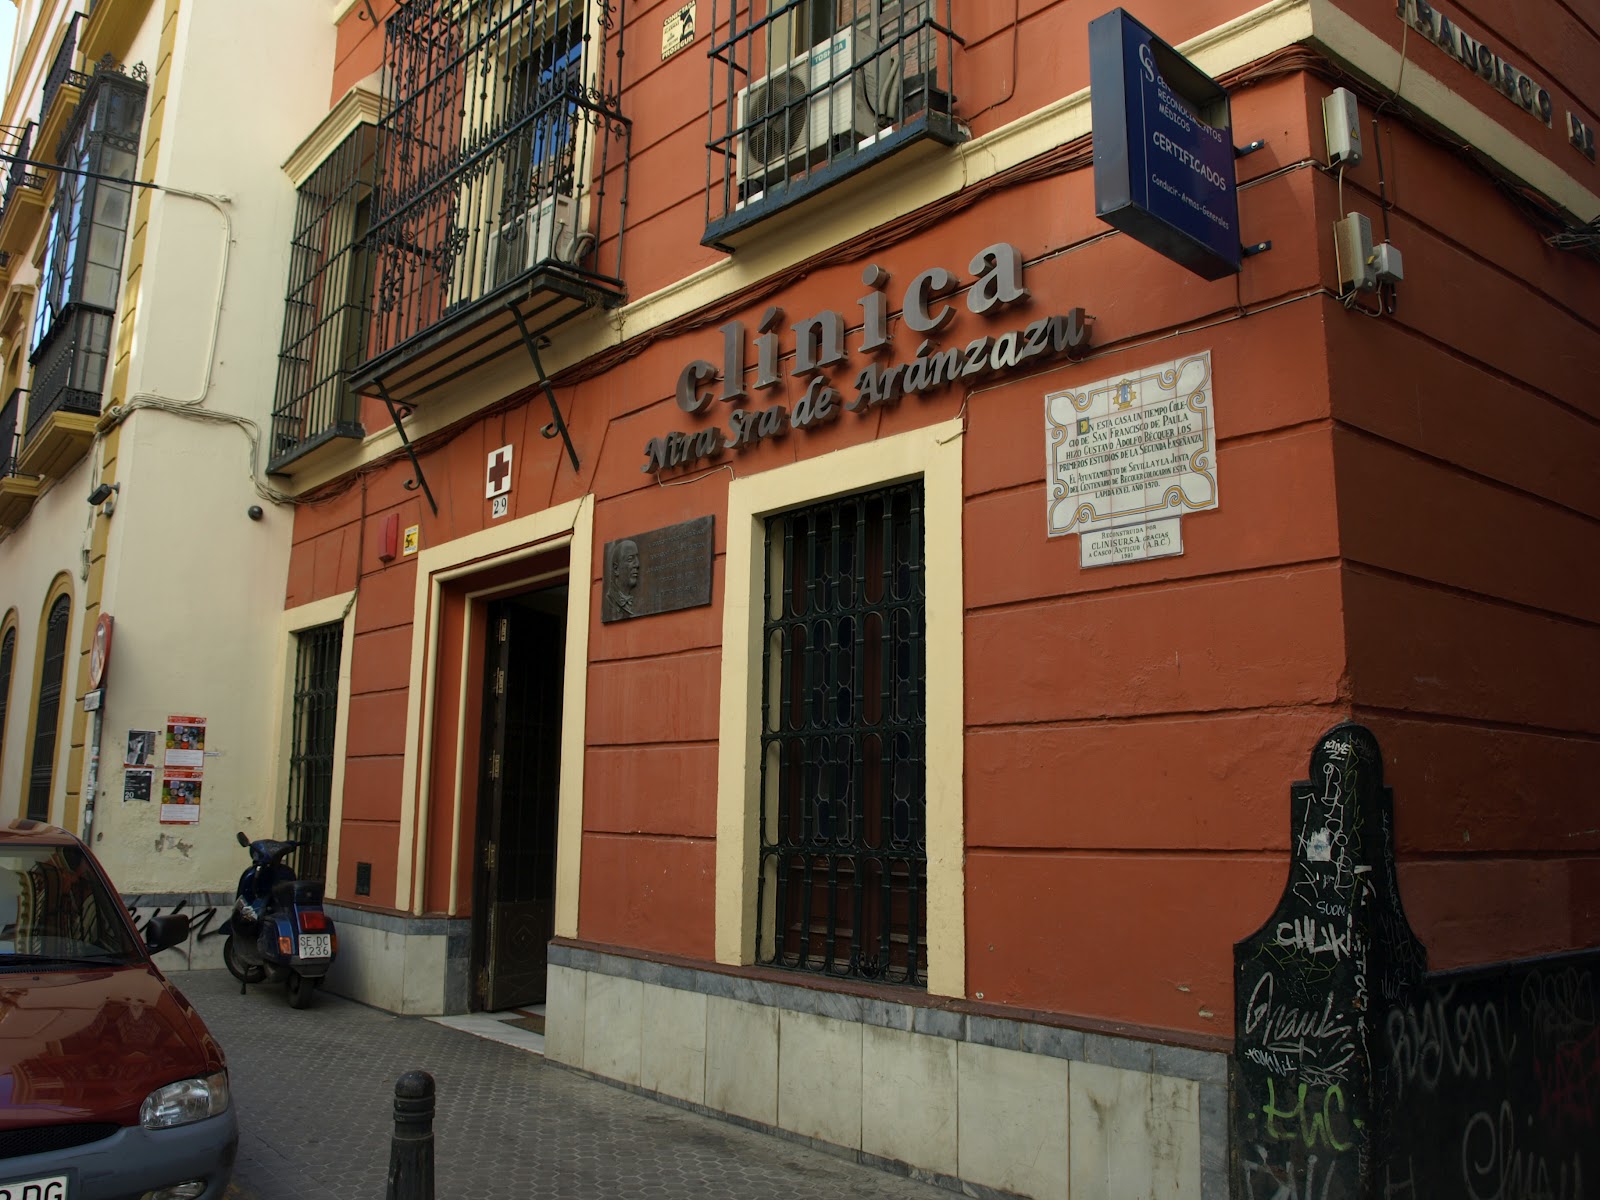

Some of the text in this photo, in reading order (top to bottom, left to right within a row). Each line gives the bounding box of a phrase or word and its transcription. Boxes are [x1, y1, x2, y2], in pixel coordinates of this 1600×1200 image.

[664, 0, 695, 26] CONECTADA
[662, 35, 694, 60] PROSEGUR
[1159, 103, 1191, 132] MÉDICOS
[1152, 131, 1227, 191] CERTIFICADOS
[676, 242, 1030, 414] clínica
[640, 307, 1087, 474] Ntra Sra de Aránzazu
[1068, 412, 1189, 448] CIO DE SAN FRANCISCO DE PAULA
[1096, 419, 1113, 430] ESTA
[1114, 414, 1133, 425] CASA
[1133, 412, 1142, 421] UN
[1144, 406, 1168, 418] TIEMPO
[1066, 449, 1081, 459] HIZO
[1083, 442, 1114, 456] GUSTAVO
[1116, 436, 1142, 448] ADOLFO
[1177, 424, 1192, 434] LOS
[1059, 459, 1088, 472] PRIMEROS
[1090, 451, 1119, 465] ESTUDIOS
[1120, 450, 1129, 459] DE
[1129, 448, 1138, 457] LA
[1140, 442, 1167, 455] SEGUNDA
[1069, 474, 1076, 484] EL
[1078, 467, 1120, 481] AYUNTAMIENTO
[1128, 460, 1155, 472] SEVILLA
[1170, 453, 1189, 463] JUNTA
[1172, 464, 1187, 473] ESTA
[493, 497, 507, 515] 29
[1101, 528, 1143, 539] RECONSTRUIDA
[1143, 532, 1168, 541] GRACIAS
[1093, 549, 1112, 557] CASCO
[304, 946, 329, 956] 1236
